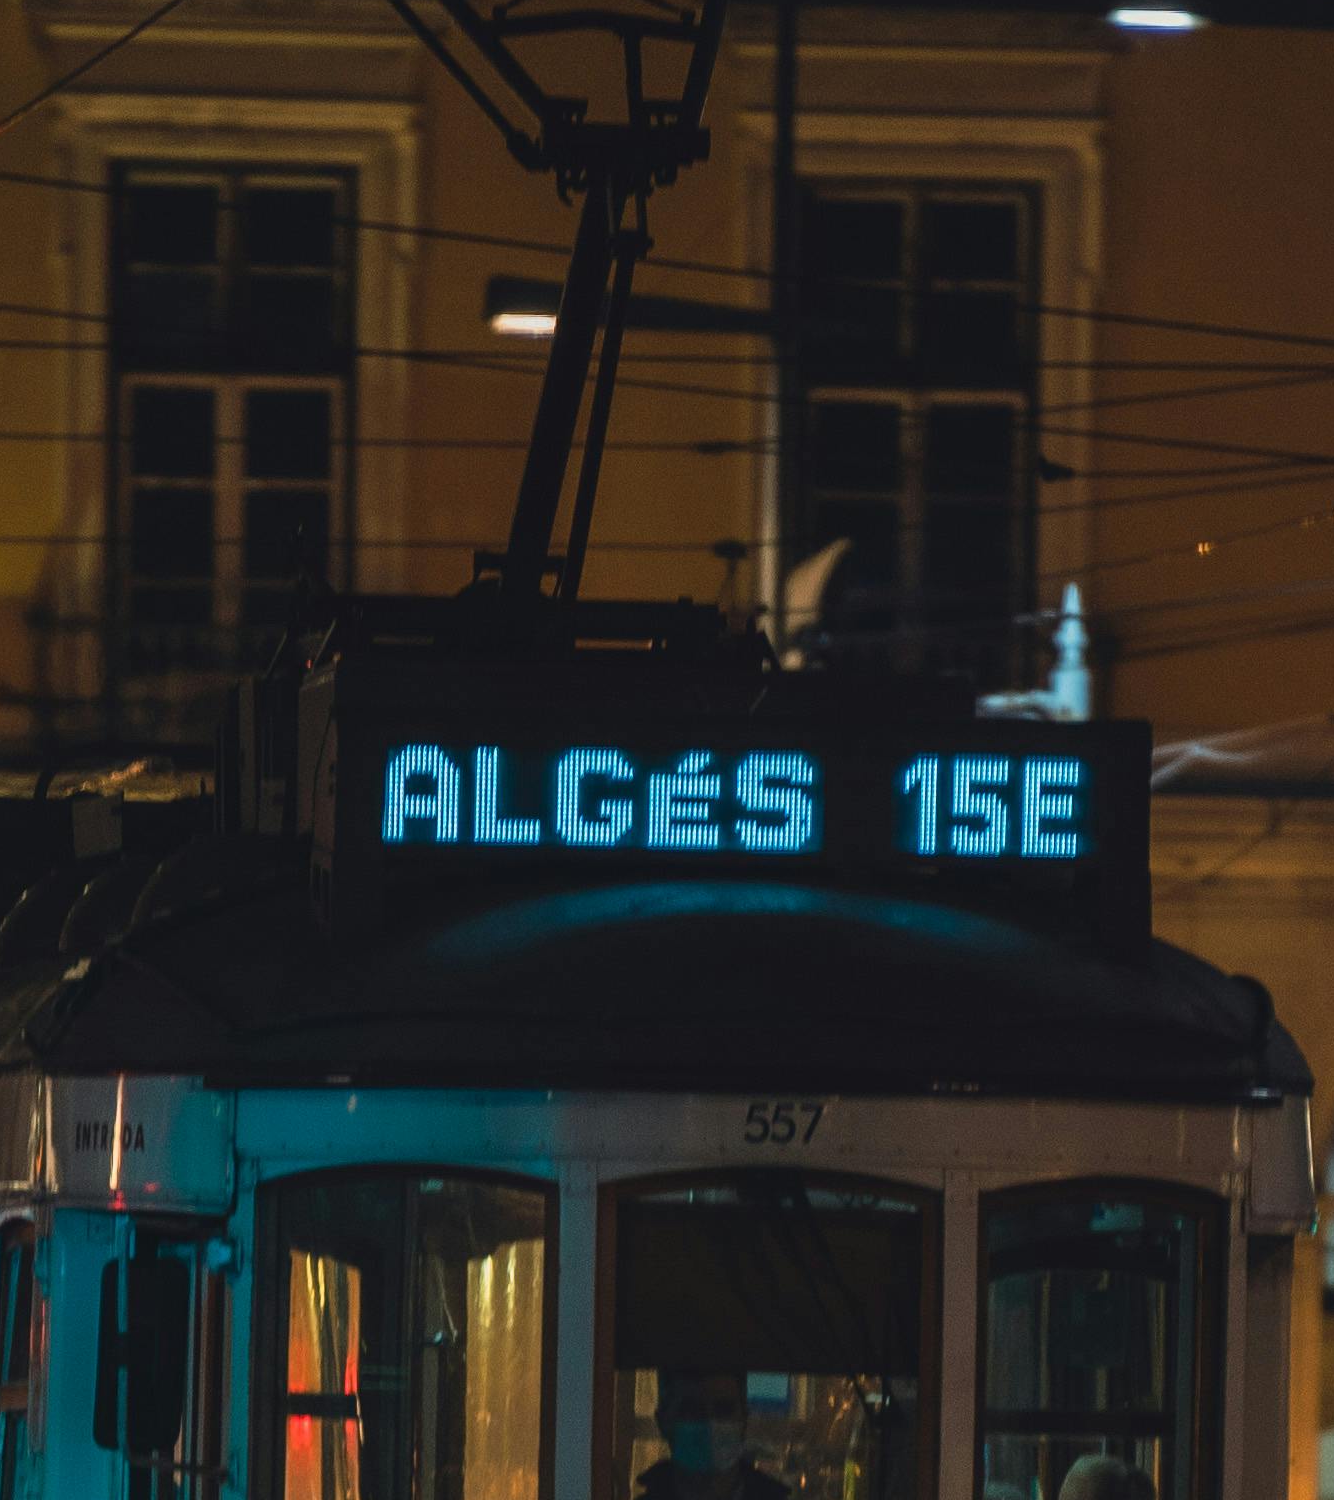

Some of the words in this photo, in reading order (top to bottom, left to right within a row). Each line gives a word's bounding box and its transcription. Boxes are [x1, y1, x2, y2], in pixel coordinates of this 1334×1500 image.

[382, 743, 816, 852] ALGÉS
[899, 752, 1082, 858] 15E
[75, 1120, 145, 1153] ENTRDA
[745, 1104, 823, 1145] 557
